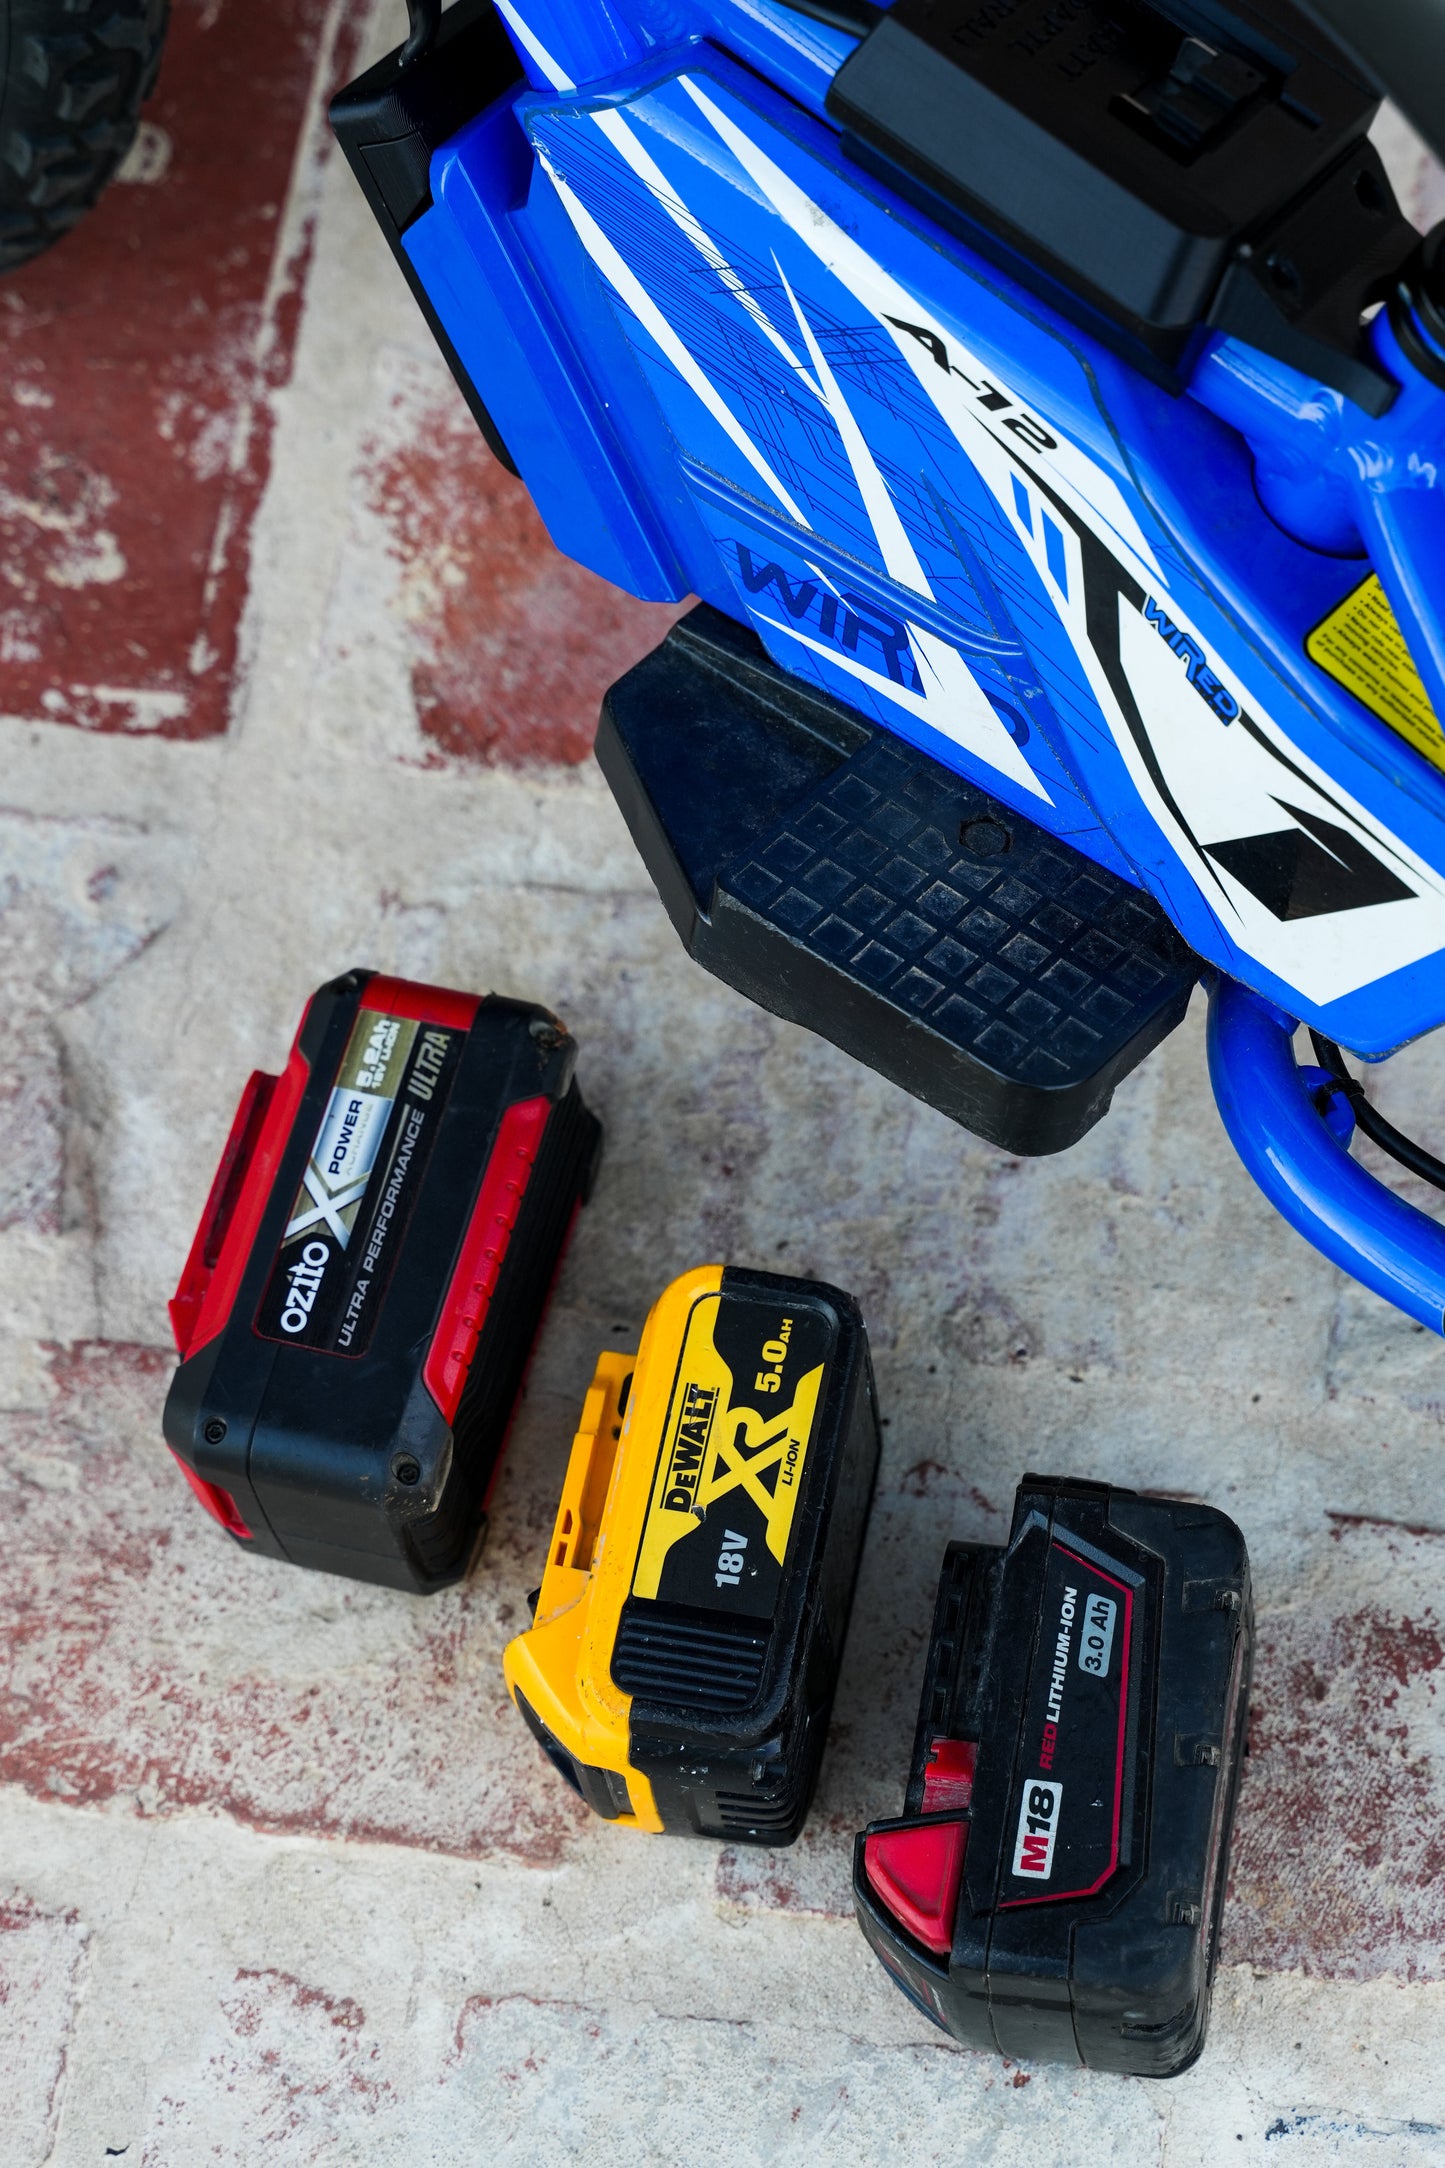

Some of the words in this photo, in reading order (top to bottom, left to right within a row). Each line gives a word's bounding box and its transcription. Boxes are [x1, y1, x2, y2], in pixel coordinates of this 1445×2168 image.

[880, 312, 1057, 454] A-12
[735, 542, 1030, 747] WIRD
[1342, 622, 1371, 647] moving
[1349, 616, 1372, 636] Never
[1369, 633, 1386, 649] ride
[1384, 646, 1402, 663] near
[1356, 608, 1369, 620] Do
[1367, 618, 1382, 631] not
[1379, 629, 1395, 643] use
[1362, 602, 1390, 626] Always
[1144, 595, 1239, 720] WIRED
[1315, 639, 1325, 649] of
[1322, 645, 1358, 677] purchase
[1356, 674, 1366, 684] or
[1363, 682, 1379, 697] any
[1321, 632, 1336, 646] For
[1333, 644, 1349, 659] any
[1347, 656, 1381, 686] concerns
[1380, 684, 1390, 694] or
[1412, 712, 1437, 735] please
[1335, 629, 1362, 653] Always
[1361, 650, 1380, 668] wear
[1384, 670, 1411, 693] helmet
[1408, 691, 1425, 706] and
[407, 1030, 451, 1101] ULTRA
[328, 1099, 363, 1175] POWER
[338, 1279, 372, 1347] ULTRA
[363, 1109, 426, 1274] PERFORMANCE
[280, 1241, 330, 1334] ozito
[704, 1406, 793, 1521] XR
[781, 1438, 801, 1487] LI-ION
[714, 1528, 749, 1589] 18V
[1085, 1635, 1106, 1671] 3.0
[1093, 1600, 1111, 1633] Ah
[1020, 1785, 1055, 1872] M18
